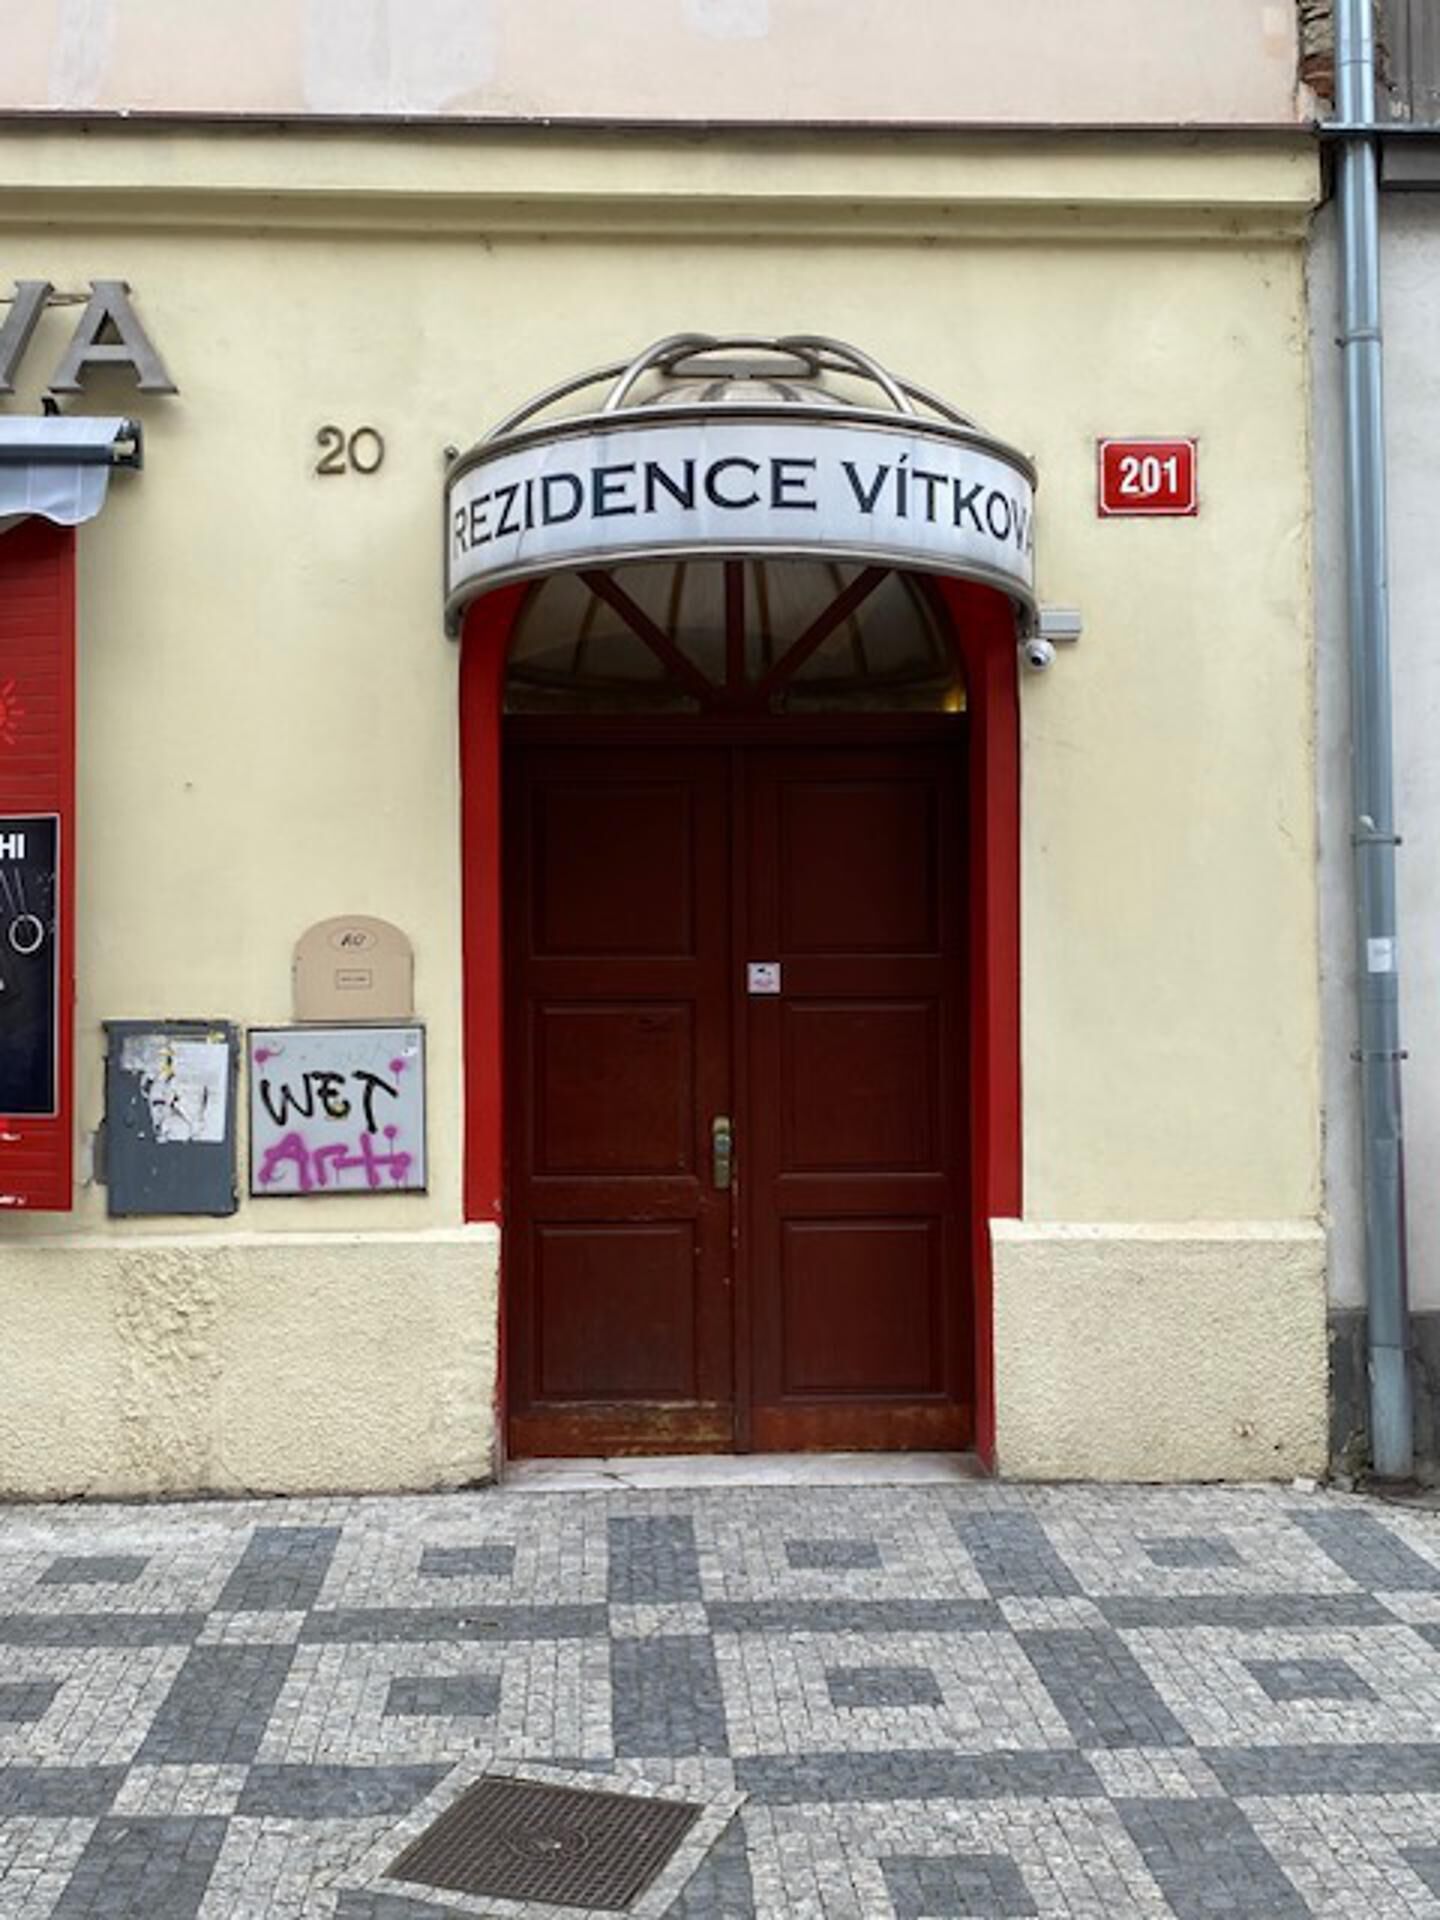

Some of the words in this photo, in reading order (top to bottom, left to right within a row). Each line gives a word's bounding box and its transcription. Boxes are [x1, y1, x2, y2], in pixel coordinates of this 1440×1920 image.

[316, 425, 385, 475] 20
[1119, 456, 1178, 495] 201
[453, 457, 818, 560] REZIDENCE
[260, 1070, 399, 1134] WET
